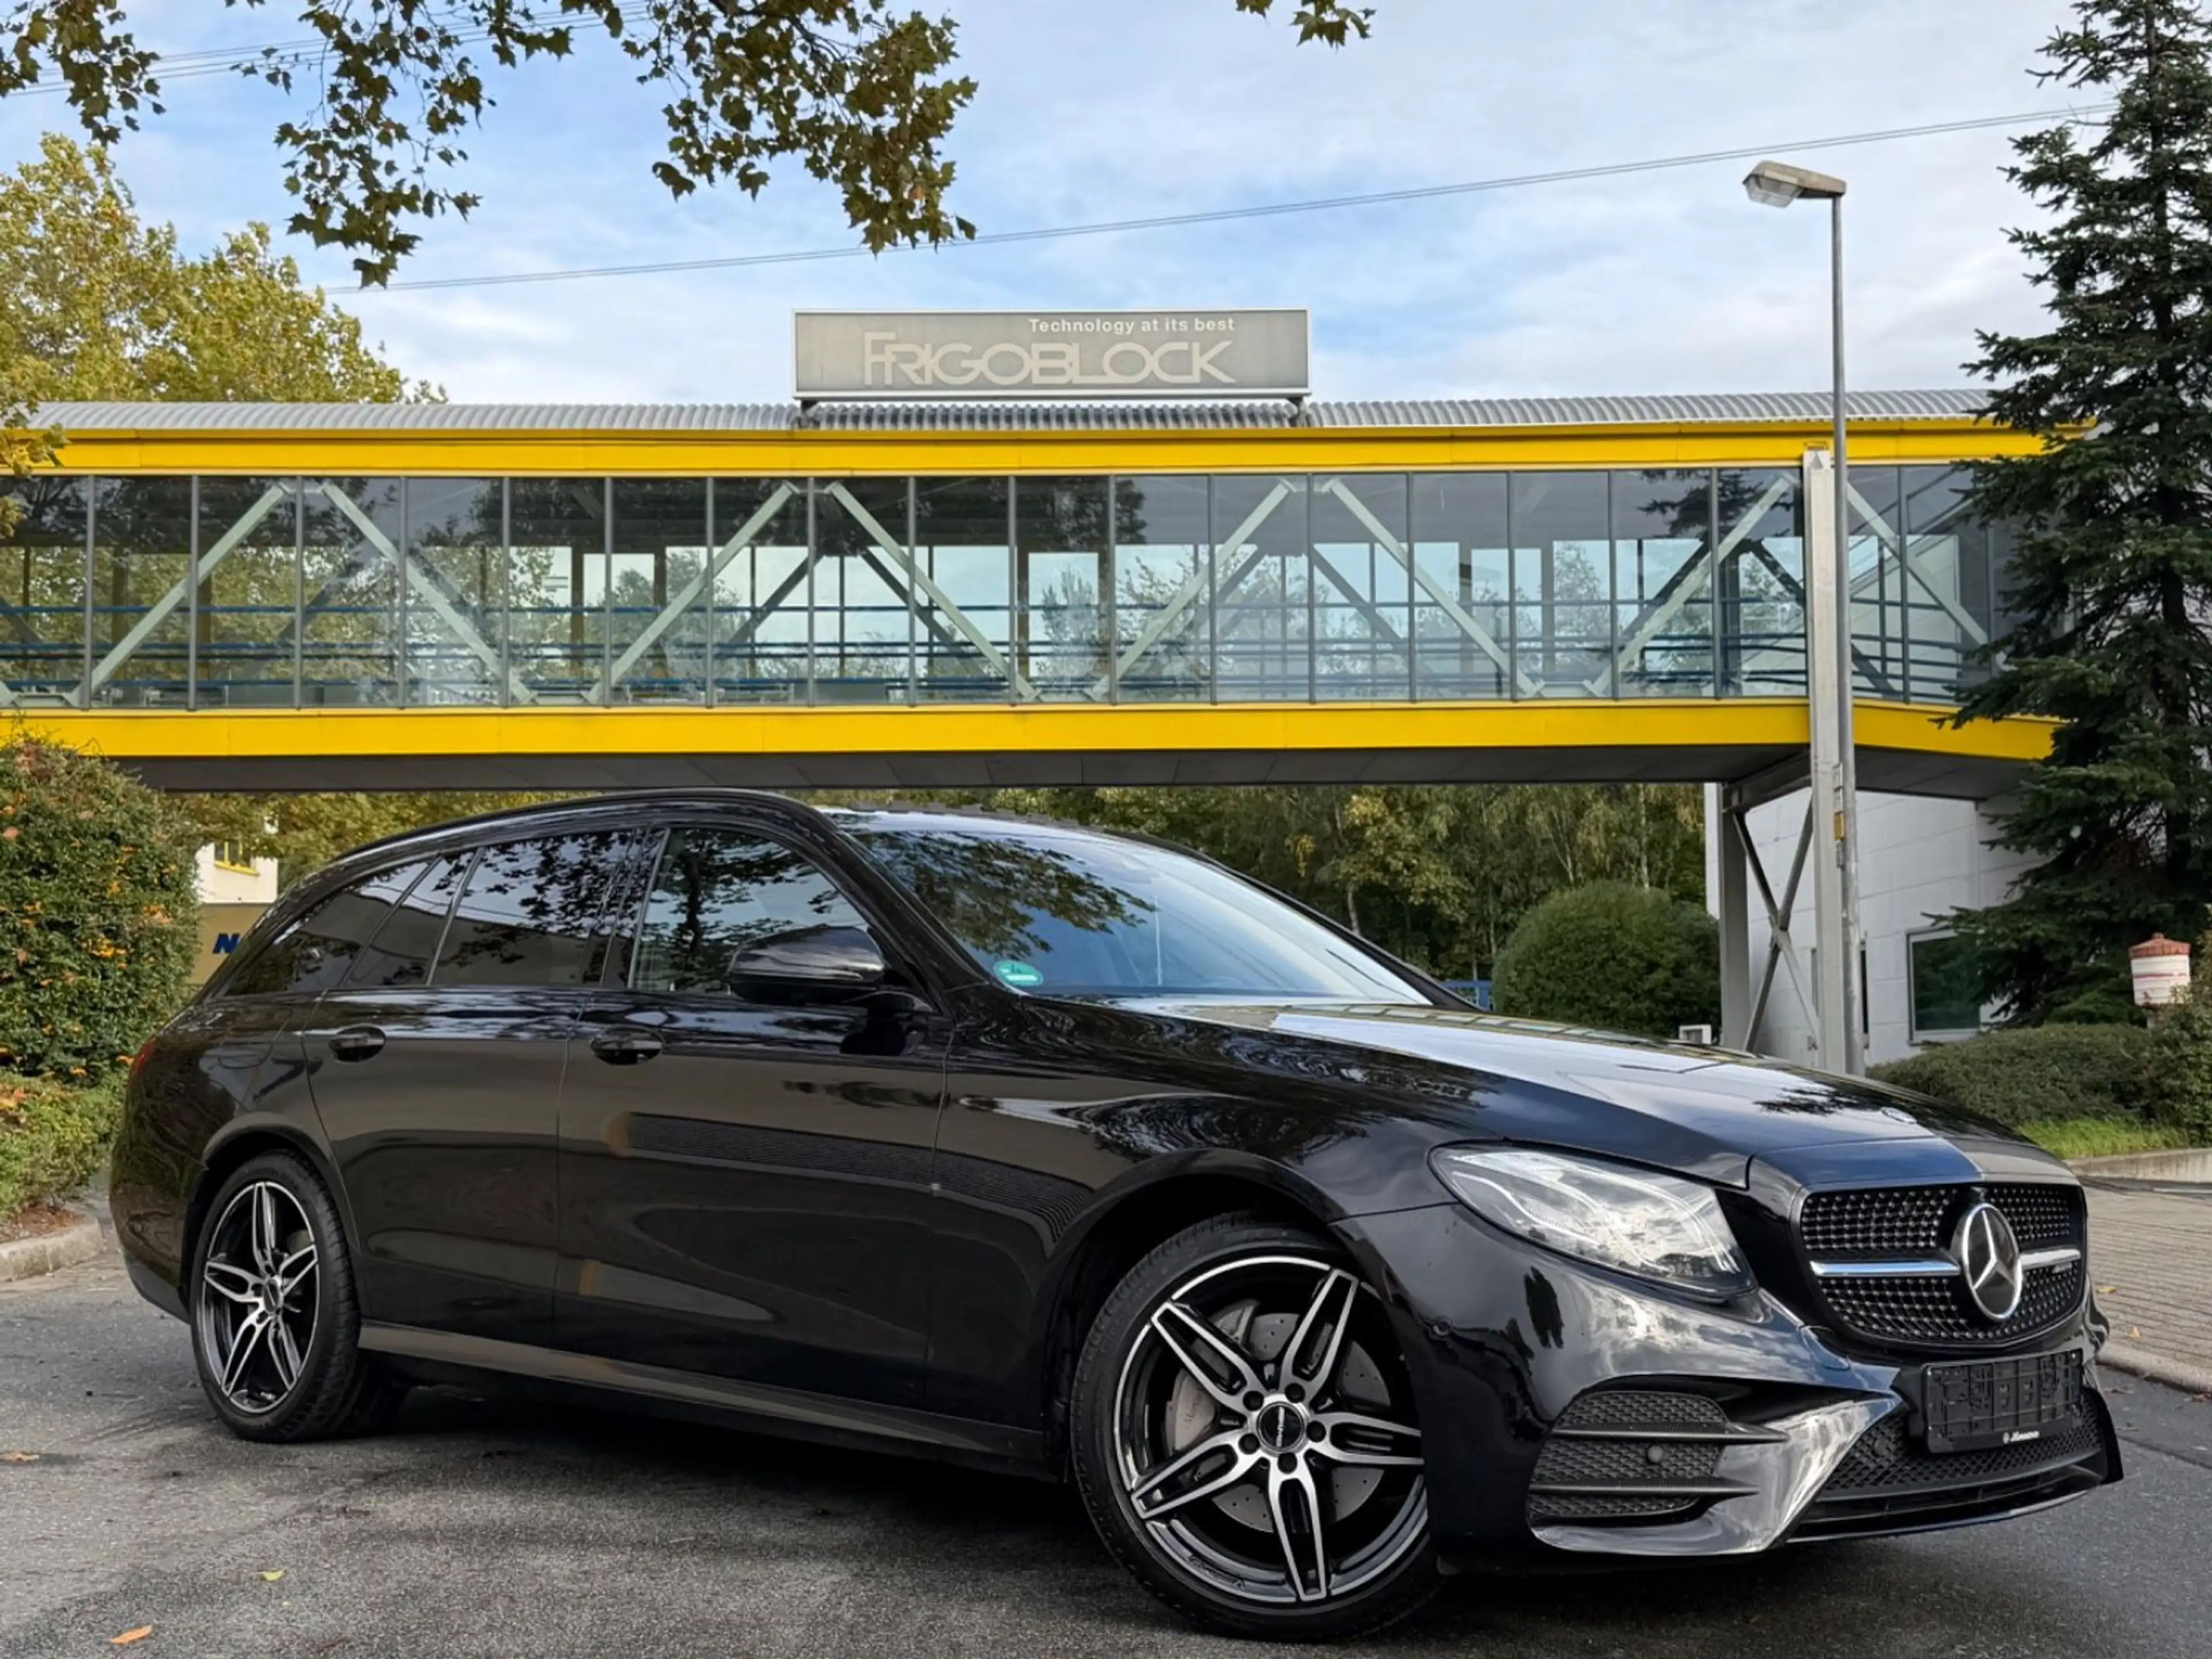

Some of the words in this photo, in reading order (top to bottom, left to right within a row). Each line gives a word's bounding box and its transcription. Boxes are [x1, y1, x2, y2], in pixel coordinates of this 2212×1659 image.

[1028, 318, 1135, 335] Technology
[1141, 319, 1159, 332] at
[1165, 317, 1188, 331] its
[1194, 317, 1236, 332] best
[864, 332, 1236, 385] FRIGOBLOCK
